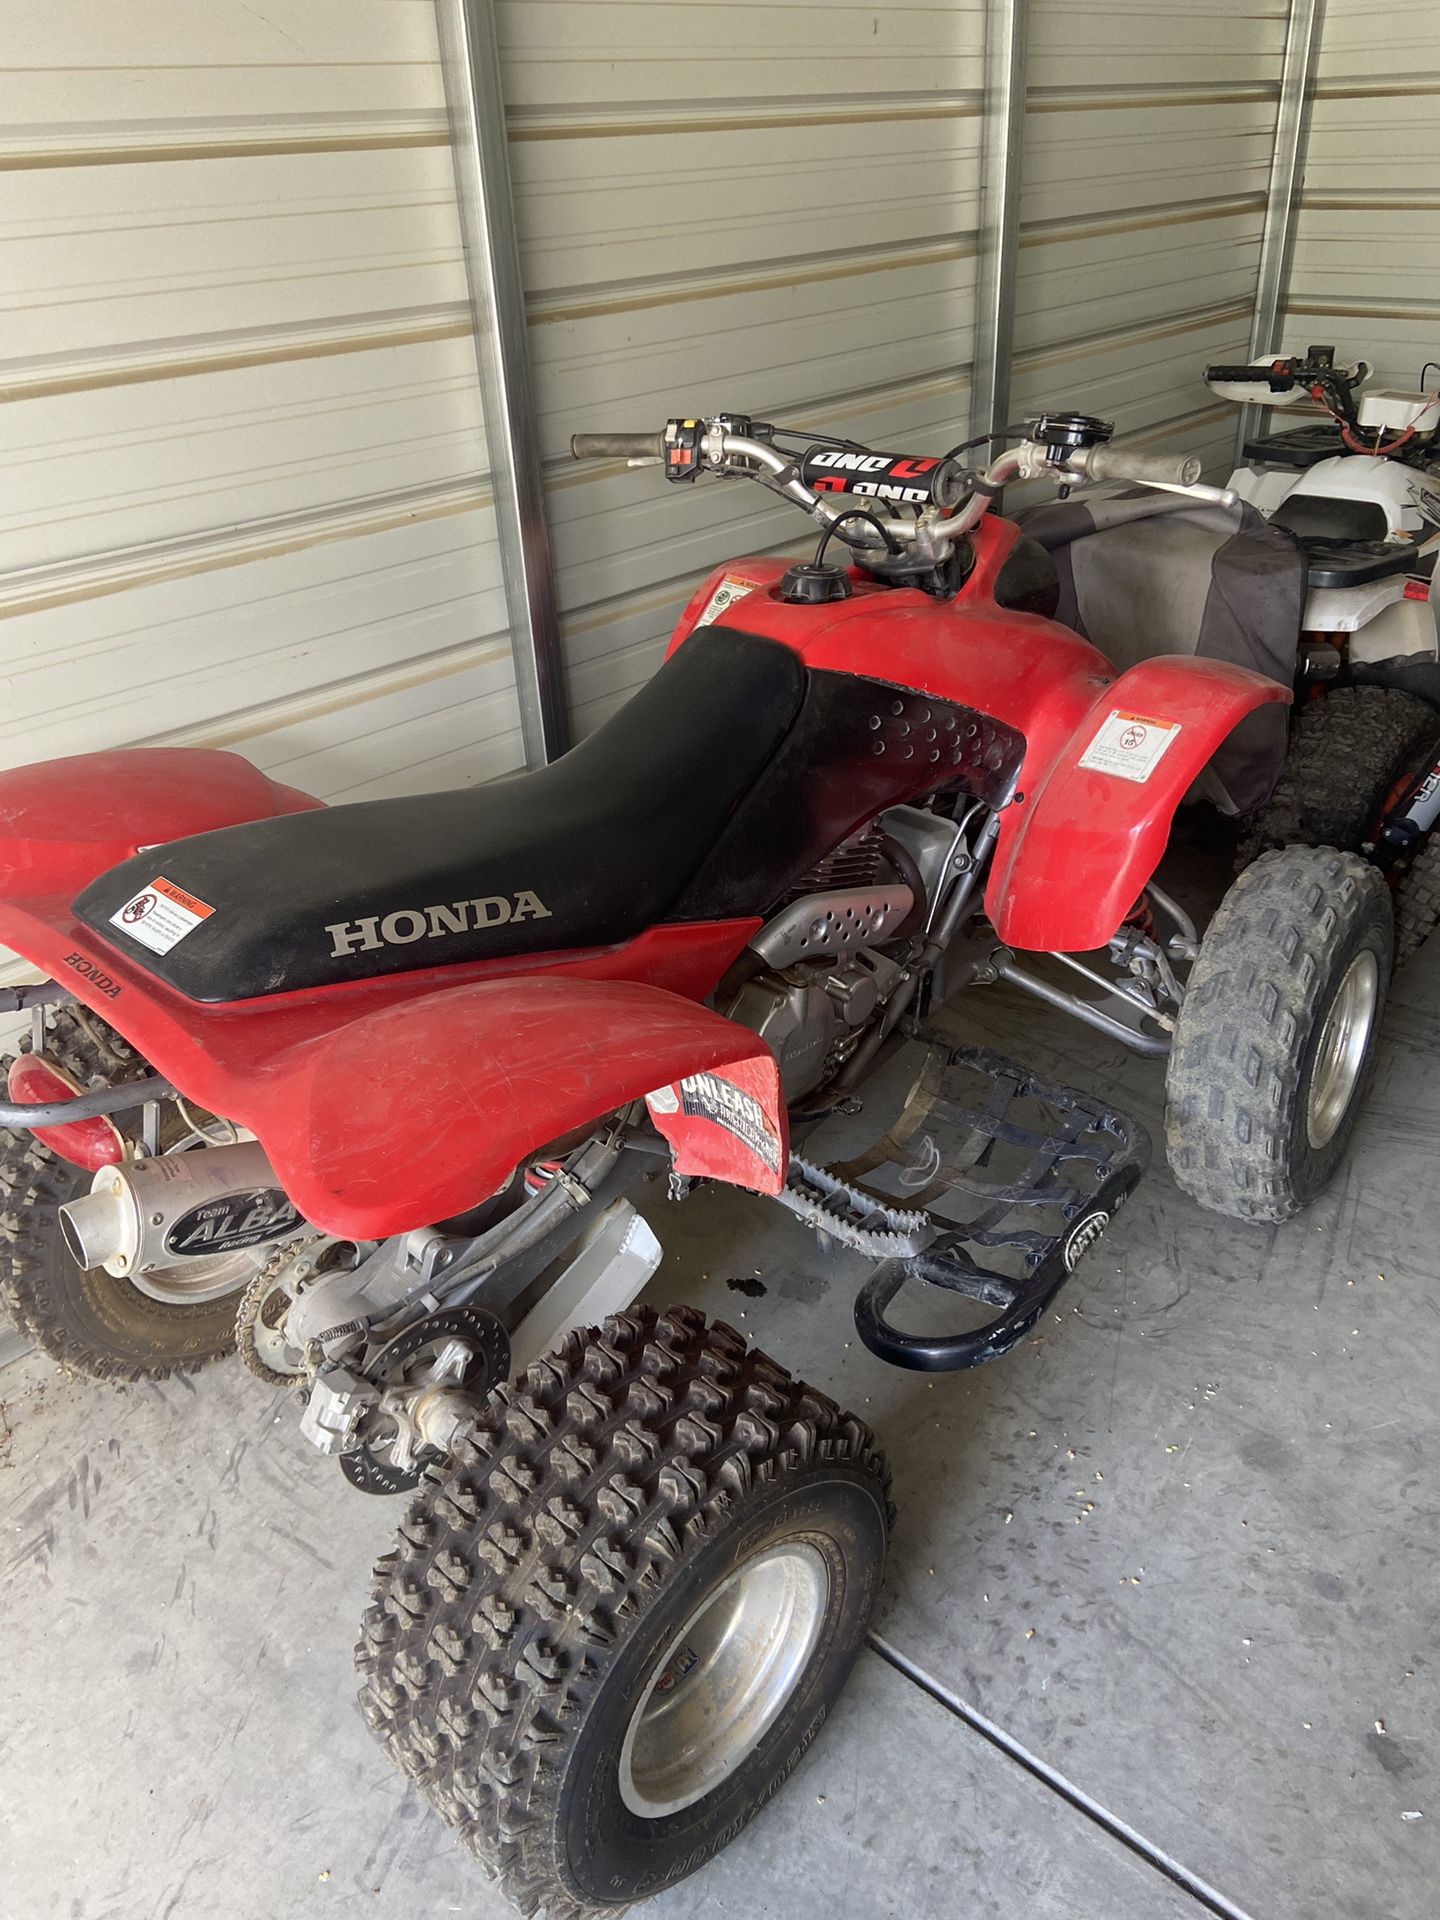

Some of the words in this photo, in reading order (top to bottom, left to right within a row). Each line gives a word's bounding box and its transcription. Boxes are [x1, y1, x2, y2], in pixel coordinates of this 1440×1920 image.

[169, 890, 197, 908] WARNING
[325, 890, 552, 958] HONDA
[63, 952, 122, 998] HONDA
[681, 1073, 764, 1132] UNLEASH
[179, 1200, 297, 1248] ALBA
[196, 1205, 230, 1221] Team
[218, 1235, 262, 1250] Racing
